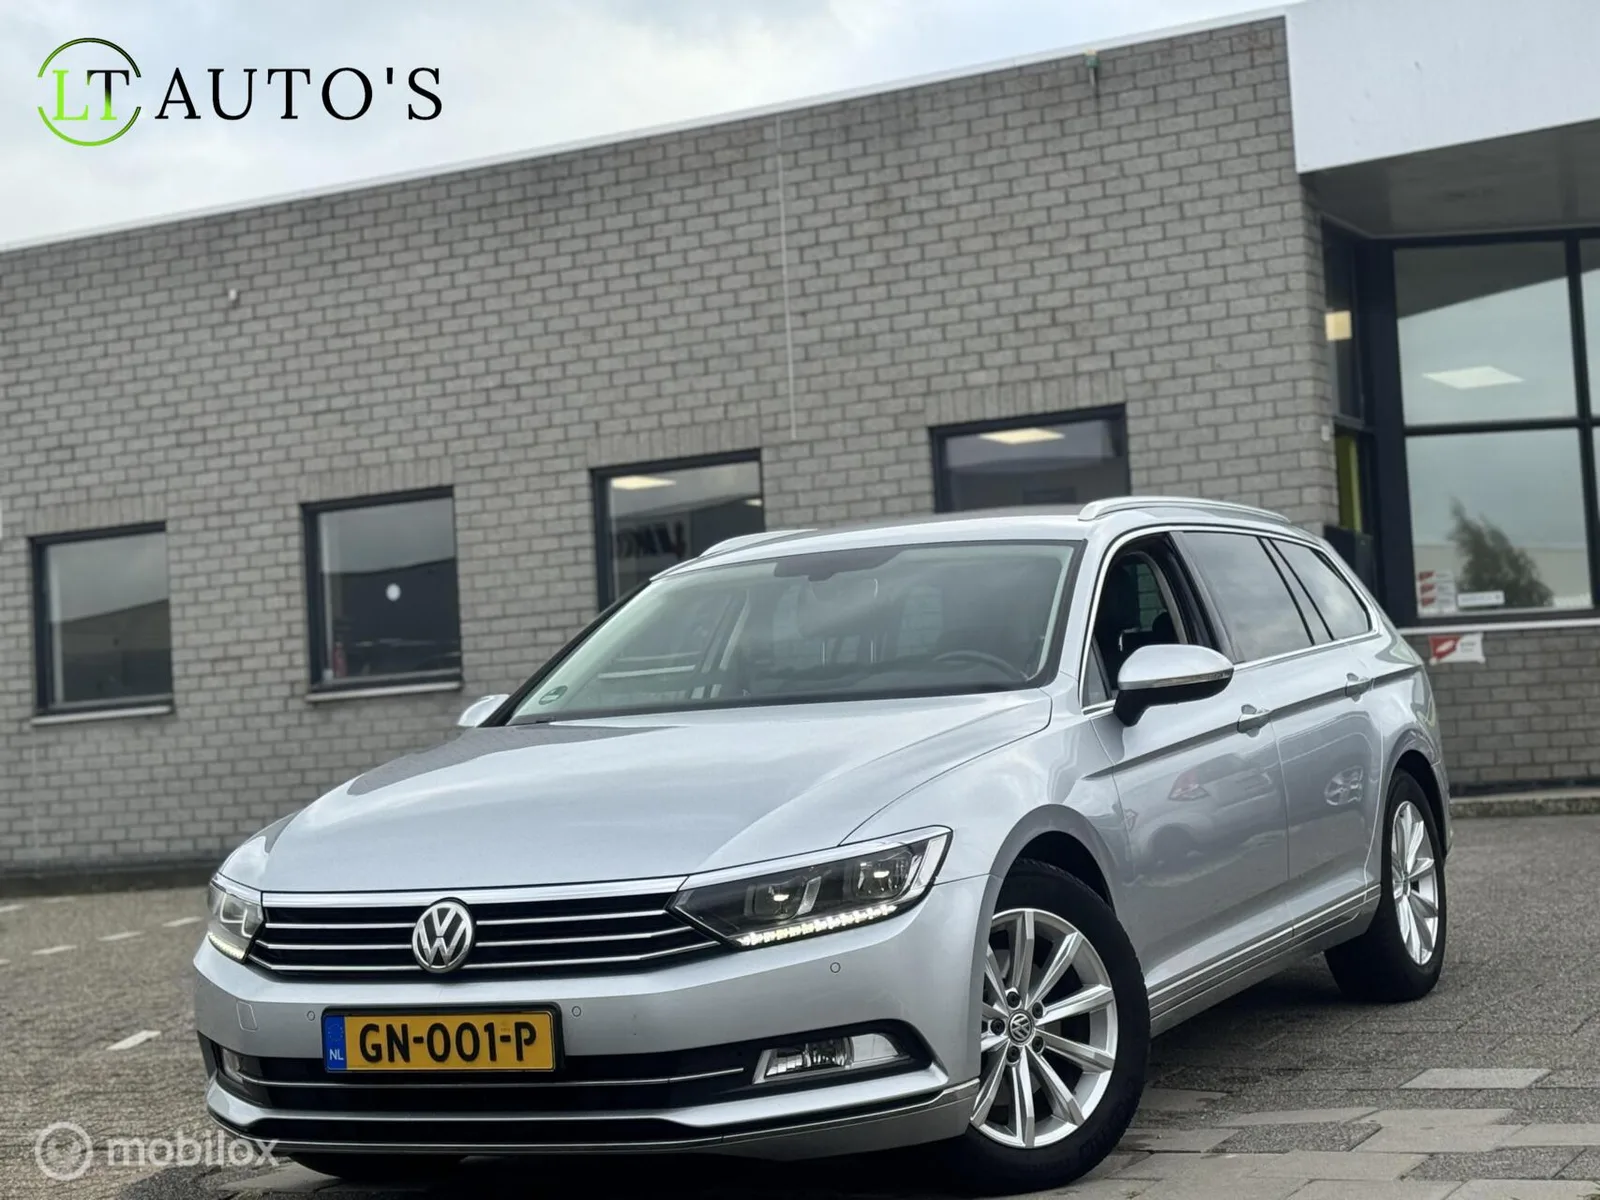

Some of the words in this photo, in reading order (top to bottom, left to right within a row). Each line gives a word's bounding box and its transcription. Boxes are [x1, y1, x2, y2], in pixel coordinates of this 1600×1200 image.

[415, 902, 471, 969] VW
[329, 1048, 344, 1061] NL
[359, 1021, 537, 1063] GN-001-P
